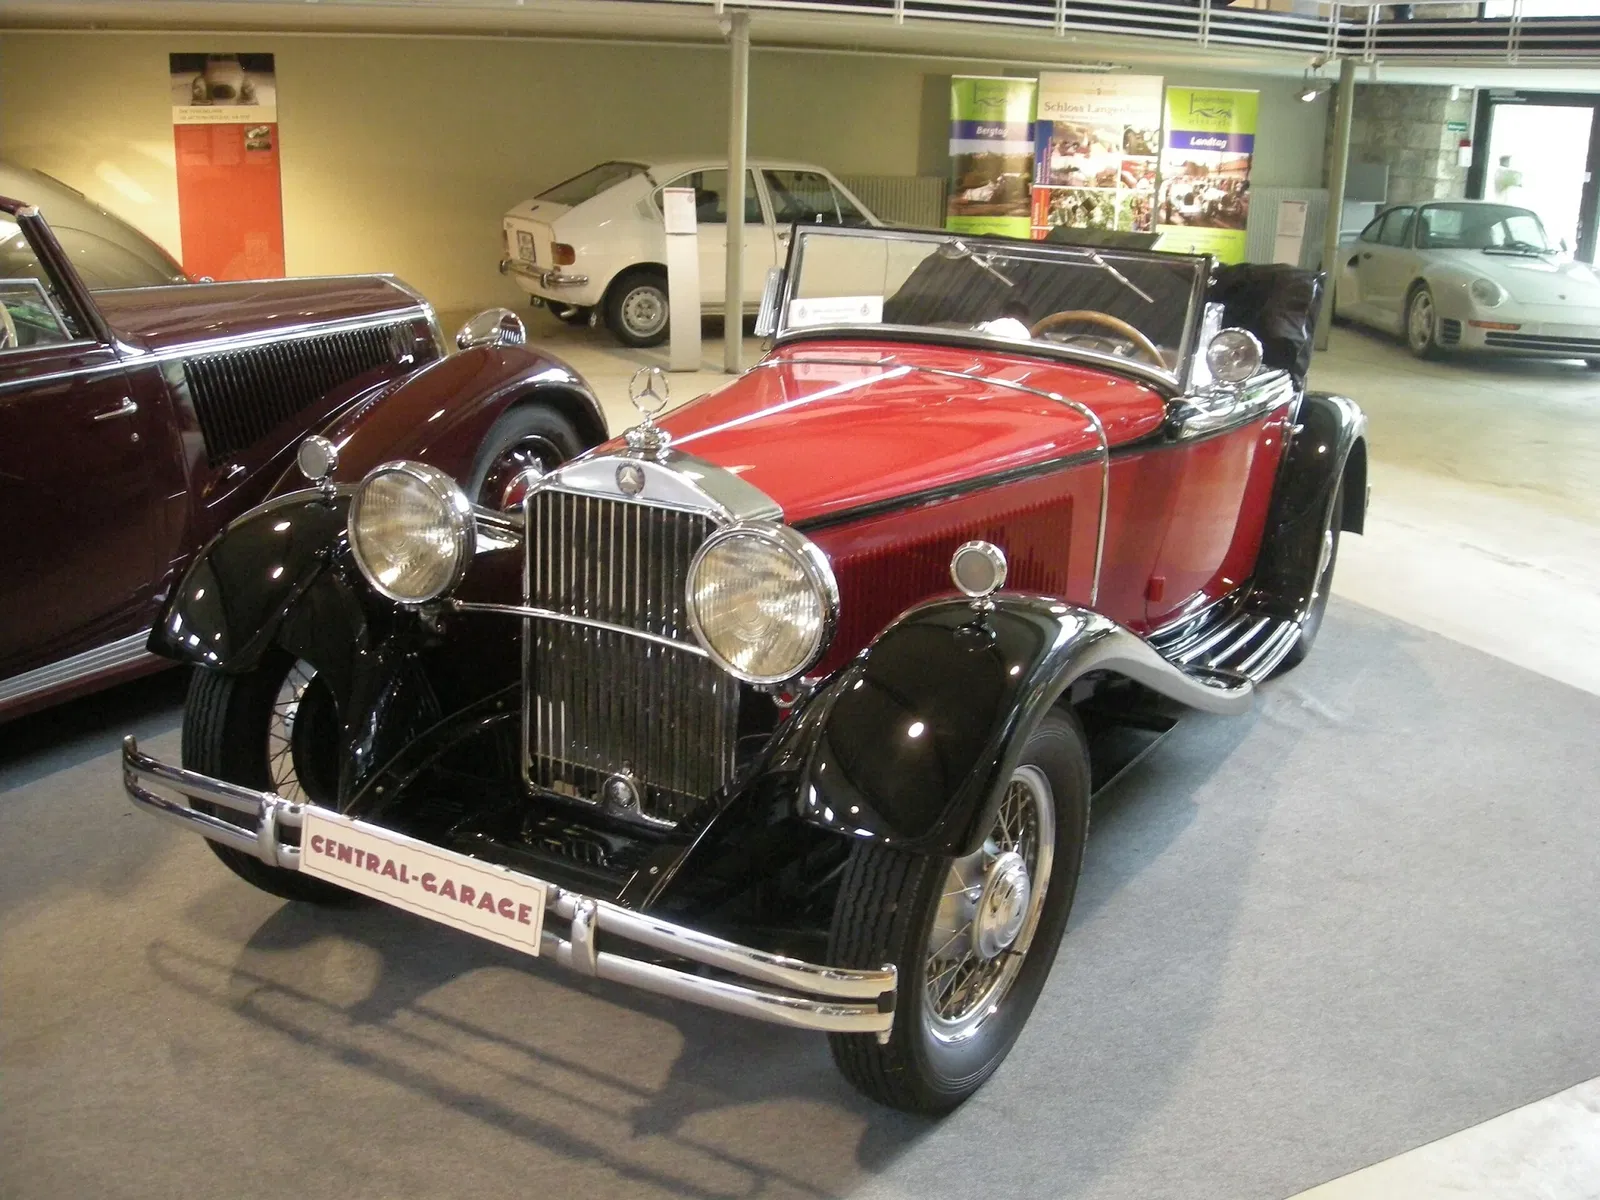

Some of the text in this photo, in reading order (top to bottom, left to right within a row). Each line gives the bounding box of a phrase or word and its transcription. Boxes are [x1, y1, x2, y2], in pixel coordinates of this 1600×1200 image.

[1044, 101, 1084, 113] Schloss
[976, 126, 1009, 138] Bergtag
[1190, 136, 1228, 149] Landtag
[310, 834, 533, 925] CENTRAL-GARAGE
